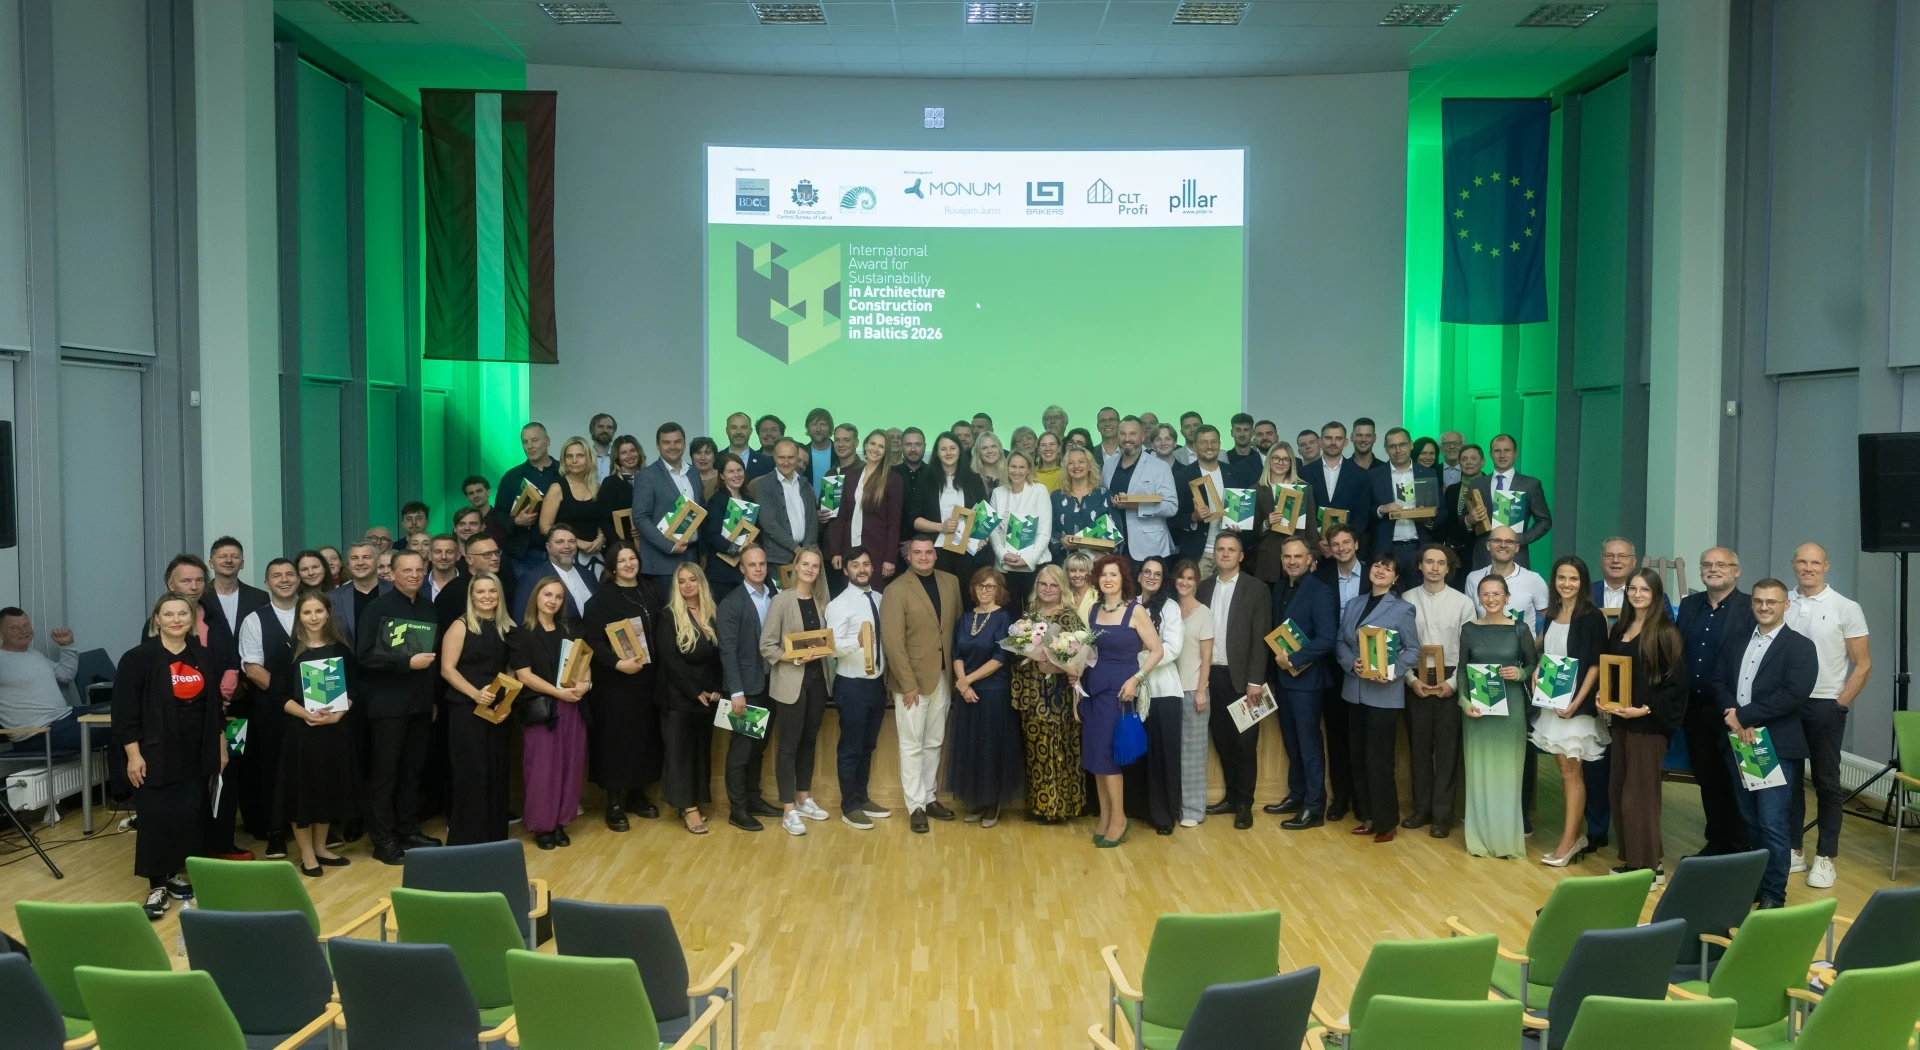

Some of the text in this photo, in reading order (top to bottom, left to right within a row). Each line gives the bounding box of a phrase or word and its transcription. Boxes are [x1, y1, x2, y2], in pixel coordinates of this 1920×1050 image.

[929, 181, 1001, 196] MONUM
[739, 197, 767, 208] BDCC
[1118, 193, 1141, 203] CLT
[1169, 179, 1218, 213] pillar
[1118, 204, 1148, 215] Profi
[849, 243, 928, 256] International
[848, 257, 909, 270] Award for
[848, 271, 931, 287] Sustainability
[848, 285, 945, 298] in Architecture
[848, 298, 933, 311] Construction
[848, 313, 921, 328] and Design
[848, 327, 943, 340] in Baltics 2026
